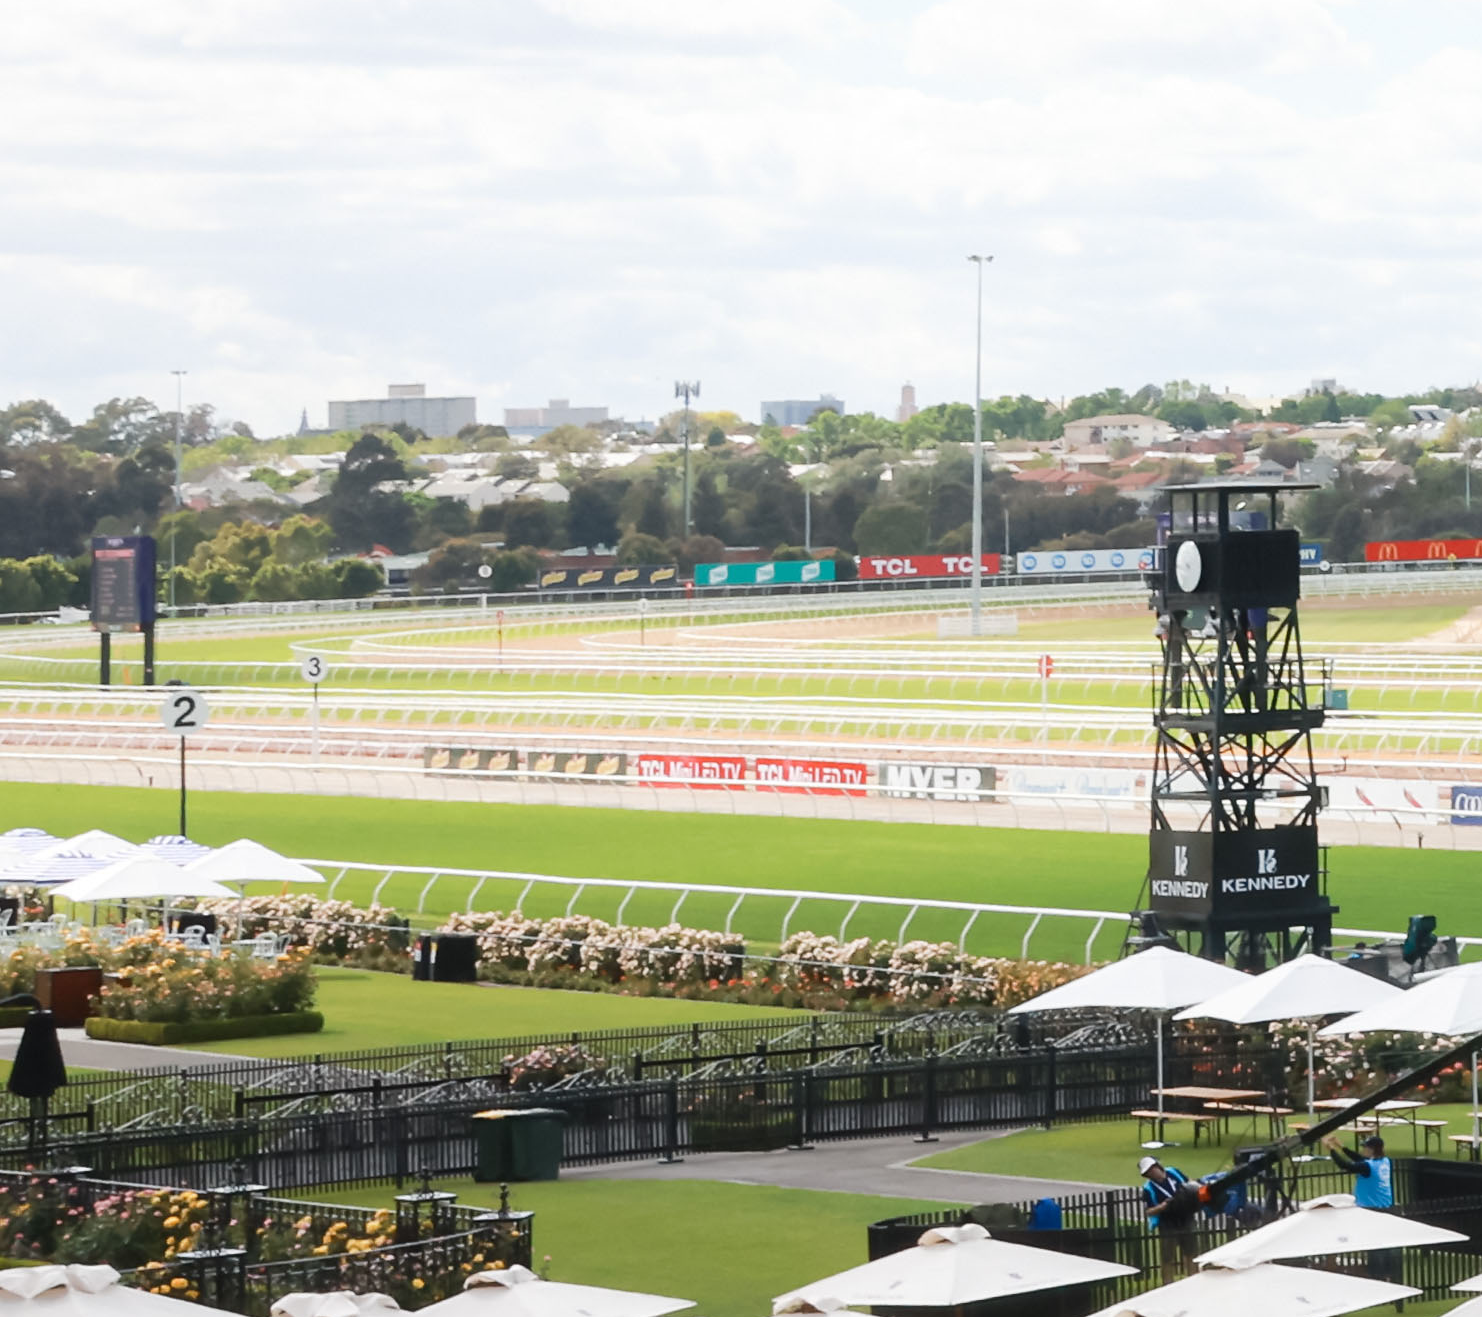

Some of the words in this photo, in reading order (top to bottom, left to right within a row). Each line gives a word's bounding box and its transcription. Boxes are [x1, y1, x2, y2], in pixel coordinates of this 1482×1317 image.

[871, 558, 917, 575] TCL
[309, 657, 321, 676] 3
[174, 696, 197, 727] 2
[722, 763, 741, 779] TV
[843, 769, 862, 784] TV
[887, 765, 982, 801] MYER
[1152, 880, 1209, 898] KENNEDY
[1222, 875, 1310, 893] KENNEDY
